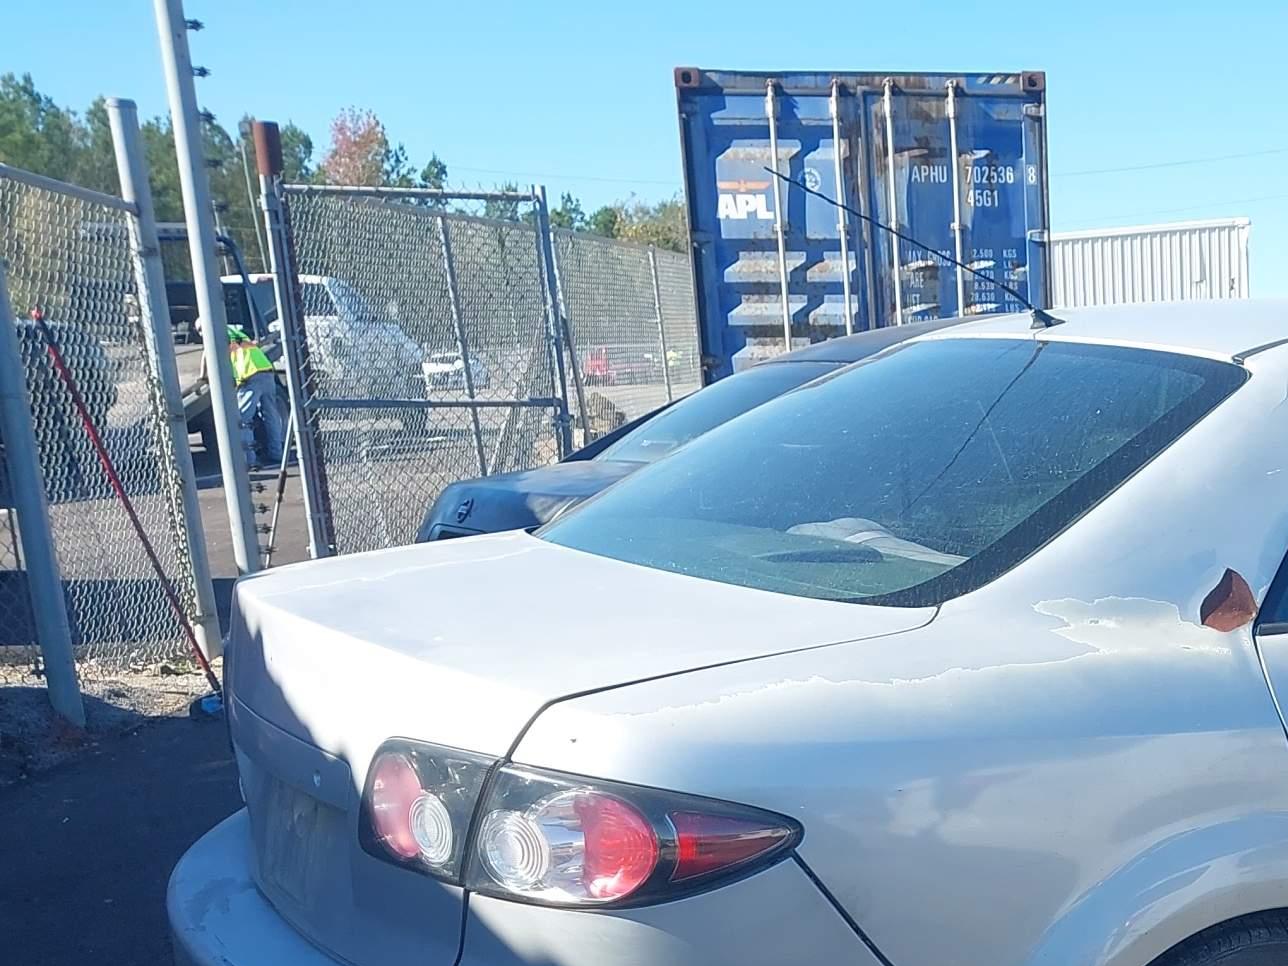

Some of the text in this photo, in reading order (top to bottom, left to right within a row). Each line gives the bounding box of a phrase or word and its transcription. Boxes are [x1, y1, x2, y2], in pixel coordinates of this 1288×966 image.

[911, 165, 1037, 184] APHU 702536 8
[717, 194, 775, 219] APL
[967, 190, 998, 207] 45G1
[1003, 249, 1017, 258] KGS
[906, 272, 925, 288] ARE
